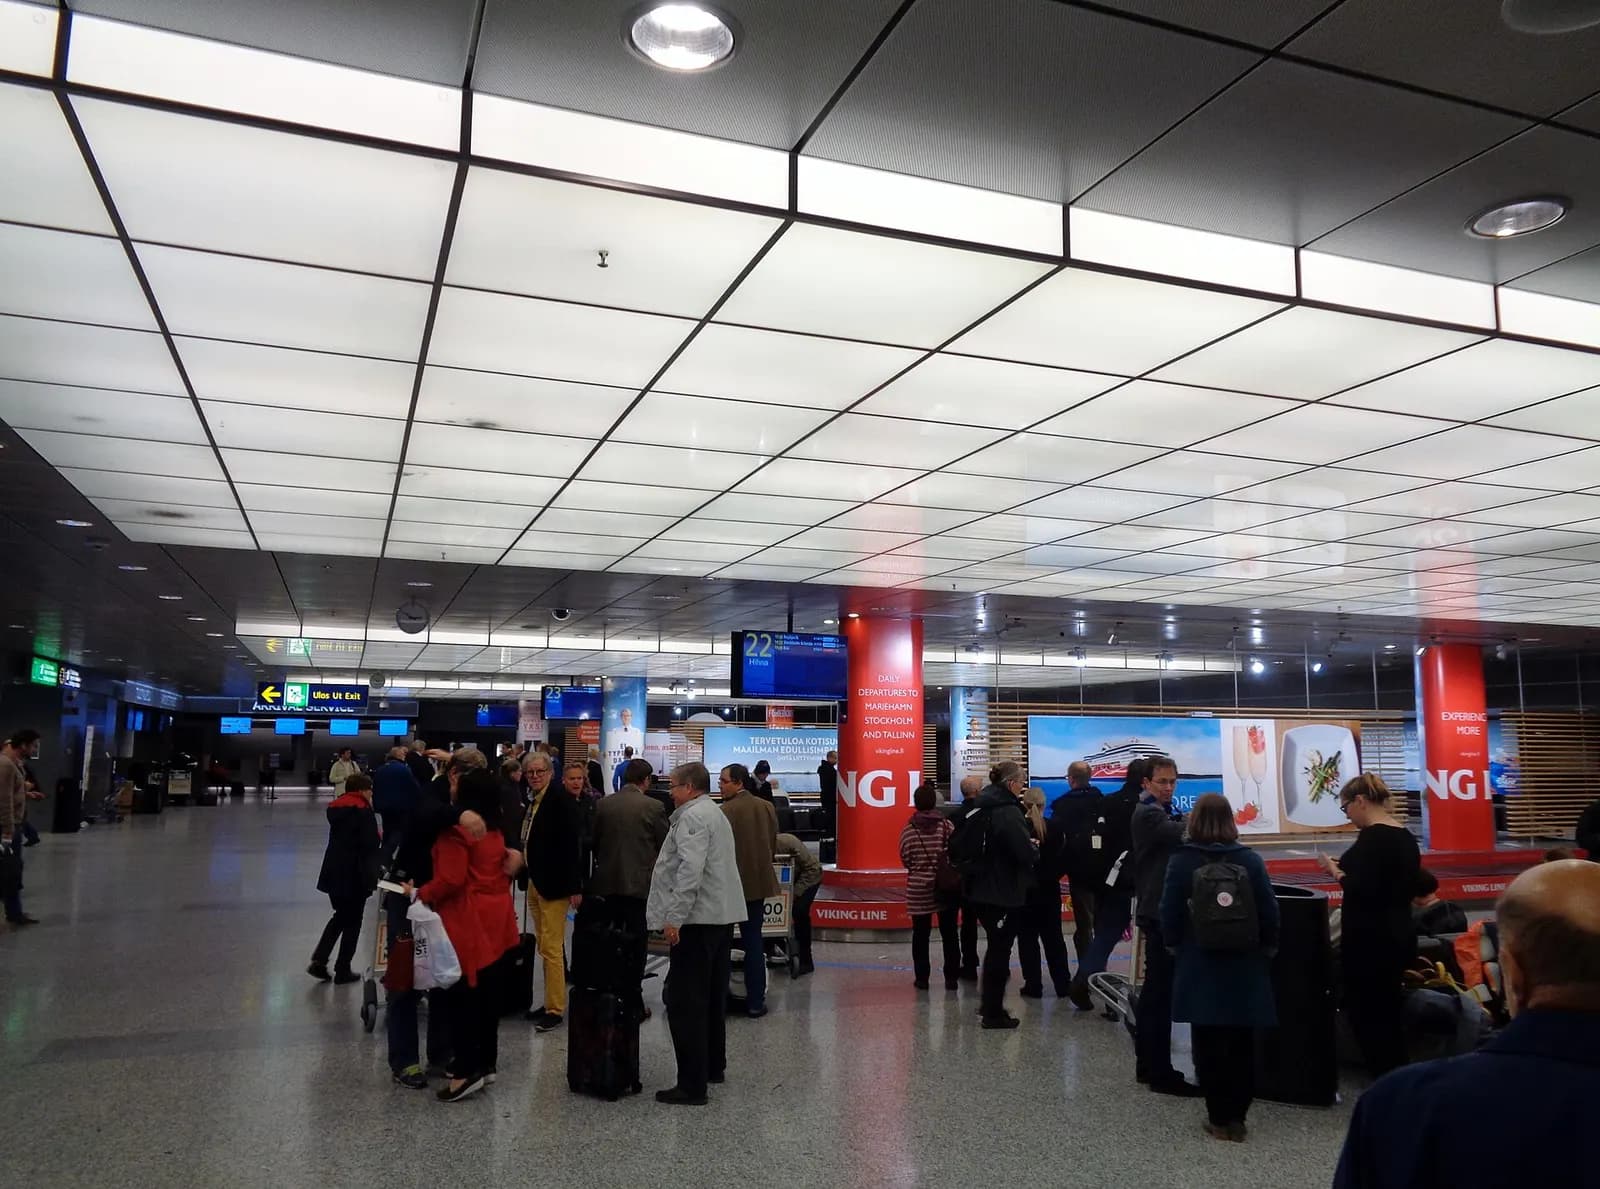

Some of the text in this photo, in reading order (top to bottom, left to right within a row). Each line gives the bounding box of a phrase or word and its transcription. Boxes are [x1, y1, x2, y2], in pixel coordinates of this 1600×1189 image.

[746, 633, 772, 657] 22
[878, 674, 900, 683] DAILY
[312, 691, 361, 700] Ulos Ut Exit
[546, 686, 561, 699] 23
[858, 688, 919, 697] DEPARTURES TO
[477, 704, 489, 713] 24
[865, 703, 913, 711] MARIEHAMN
[864, 716, 913, 725] STOCKHOLM
[863, 731, 915, 739] AND TALLINN
[1456, 726, 1481, 736] MORE
[749, 736, 804, 745] TERVETULOA
[733, 745, 779, 754] MAAILMAN
[1171, 795, 1198, 809] ORE
[1462, 884, 1489, 892] VIKING
[816, 908, 888, 921] VIKING LINE
